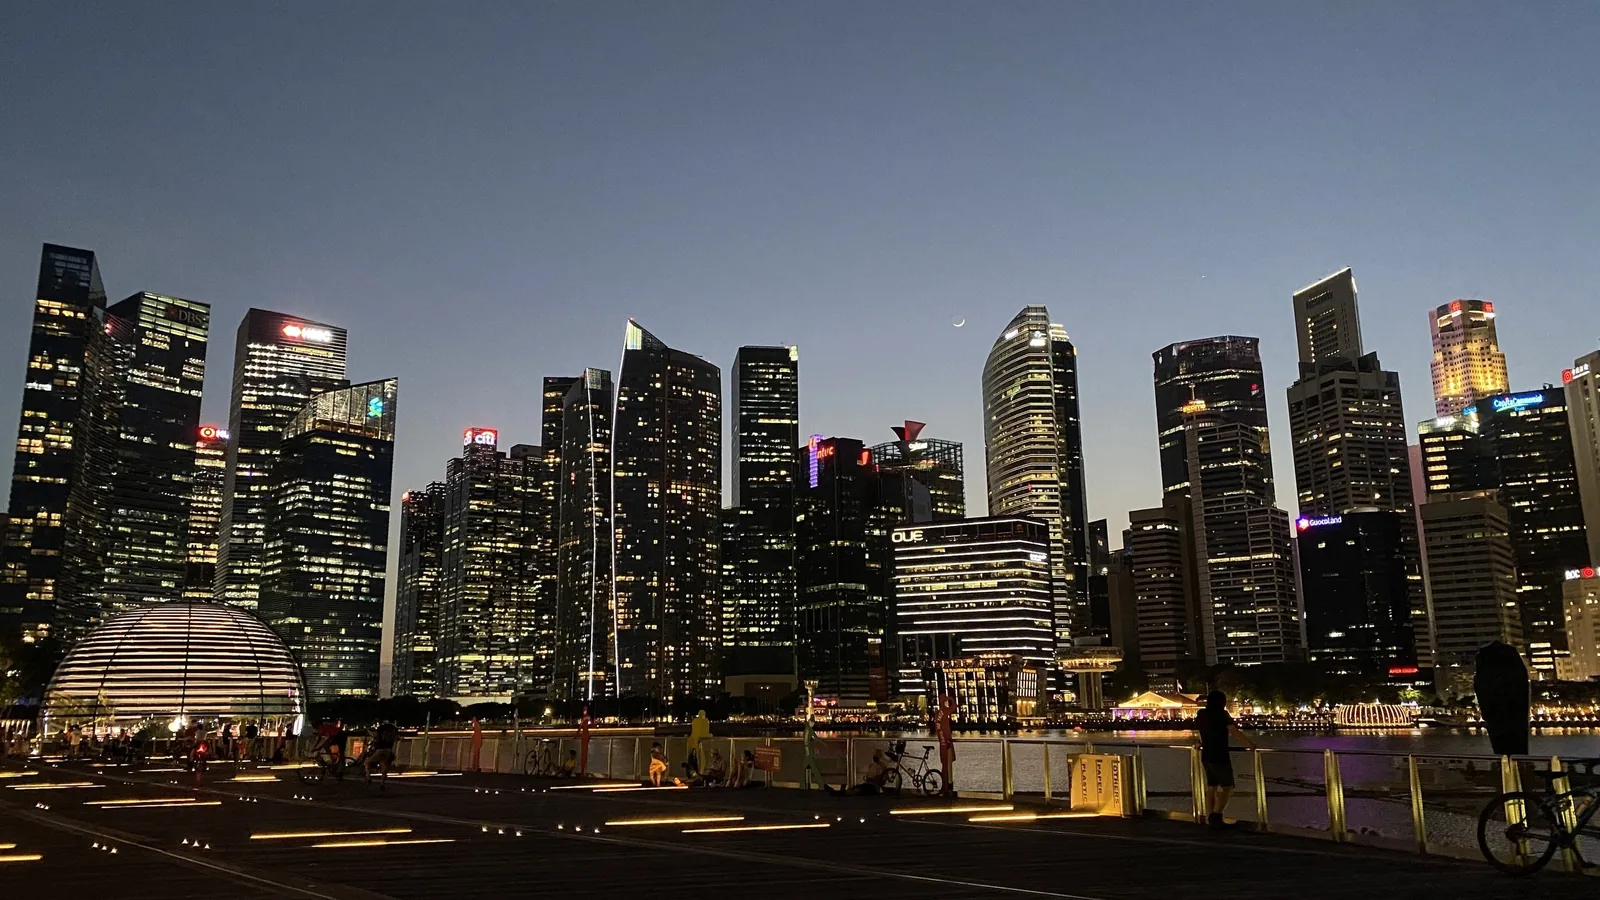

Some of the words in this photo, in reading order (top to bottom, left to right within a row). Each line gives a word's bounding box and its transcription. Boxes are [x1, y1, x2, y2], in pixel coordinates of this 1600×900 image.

[179, 309, 203, 325] DBS
[475, 434, 495, 445] citi
[1310, 516, 1342, 527] GuocoLand
[892, 530, 924, 543] OUE
[1565, 569, 1580, 580] BOC
